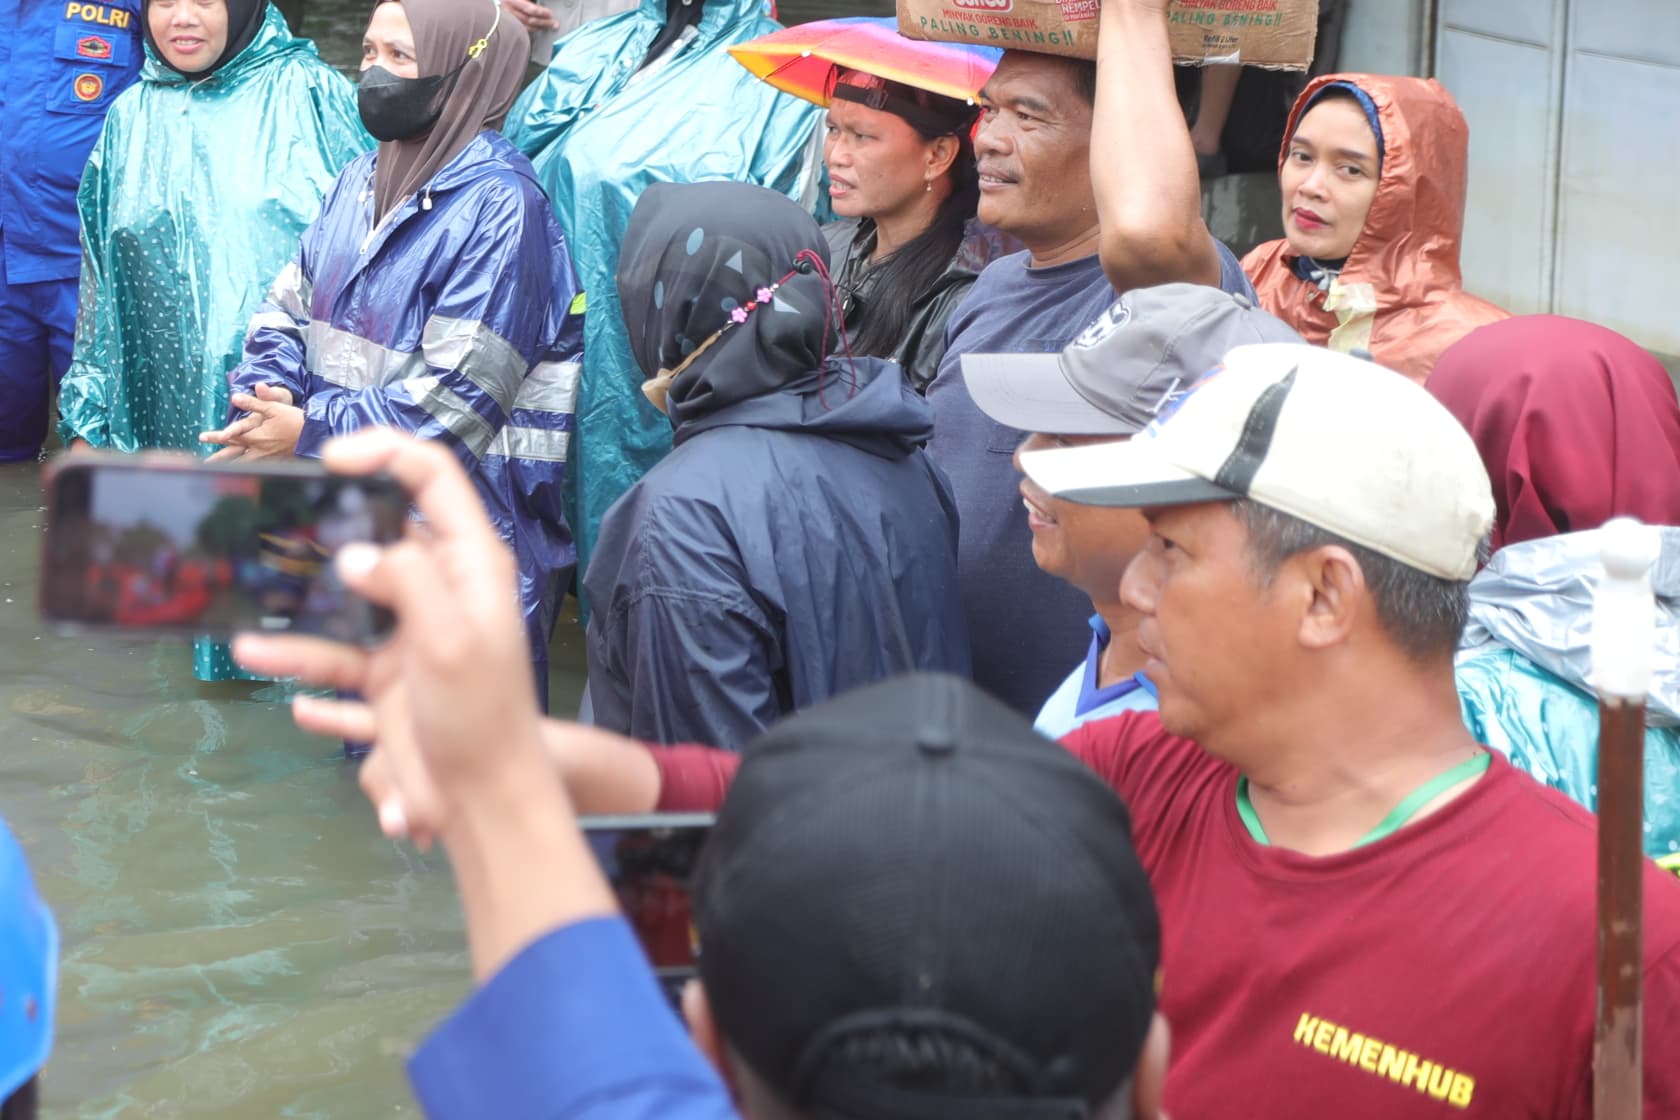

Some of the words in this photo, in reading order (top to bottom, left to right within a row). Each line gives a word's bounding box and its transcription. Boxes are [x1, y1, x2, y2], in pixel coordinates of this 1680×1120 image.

[66, 1, 132, 29] POLRI
[1061, 0, 1101, 14] NEMPEL
[1257, 0, 1278, 10] BAIK
[919, 16, 980, 38] PALING
[942, 8, 973, 22] MINYAK
[973, 12, 1014, 28] GORENG
[1013, 16, 1038, 29] BAIK
[1167, 11, 1216, 26] ALING
[1293, 1011, 1476, 1110] KEMENHUB
